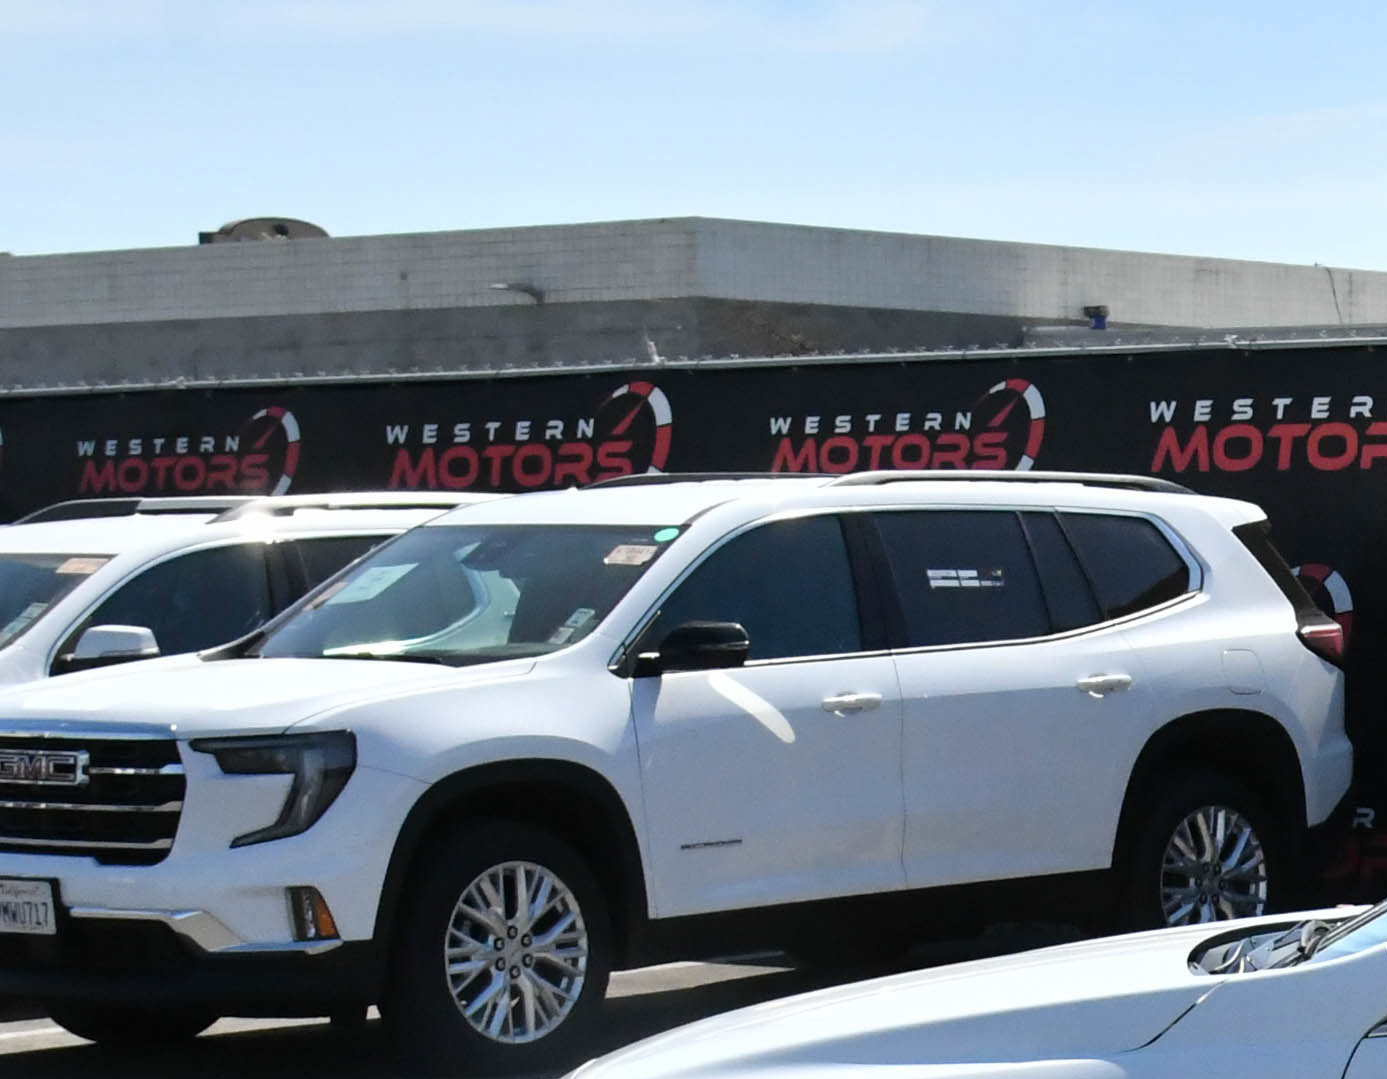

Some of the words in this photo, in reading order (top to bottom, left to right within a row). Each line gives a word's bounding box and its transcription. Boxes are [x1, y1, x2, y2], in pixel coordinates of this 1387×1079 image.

[387, 418, 594, 444] WESTERN
[770, 412, 971, 435] WESTERN
[79, 436, 239, 456] WESTERN
[772, 432, 1007, 473] MOTORS
[85, 454, 267, 491] MOTORS
[391, 440, 633, 488] MOTORS
